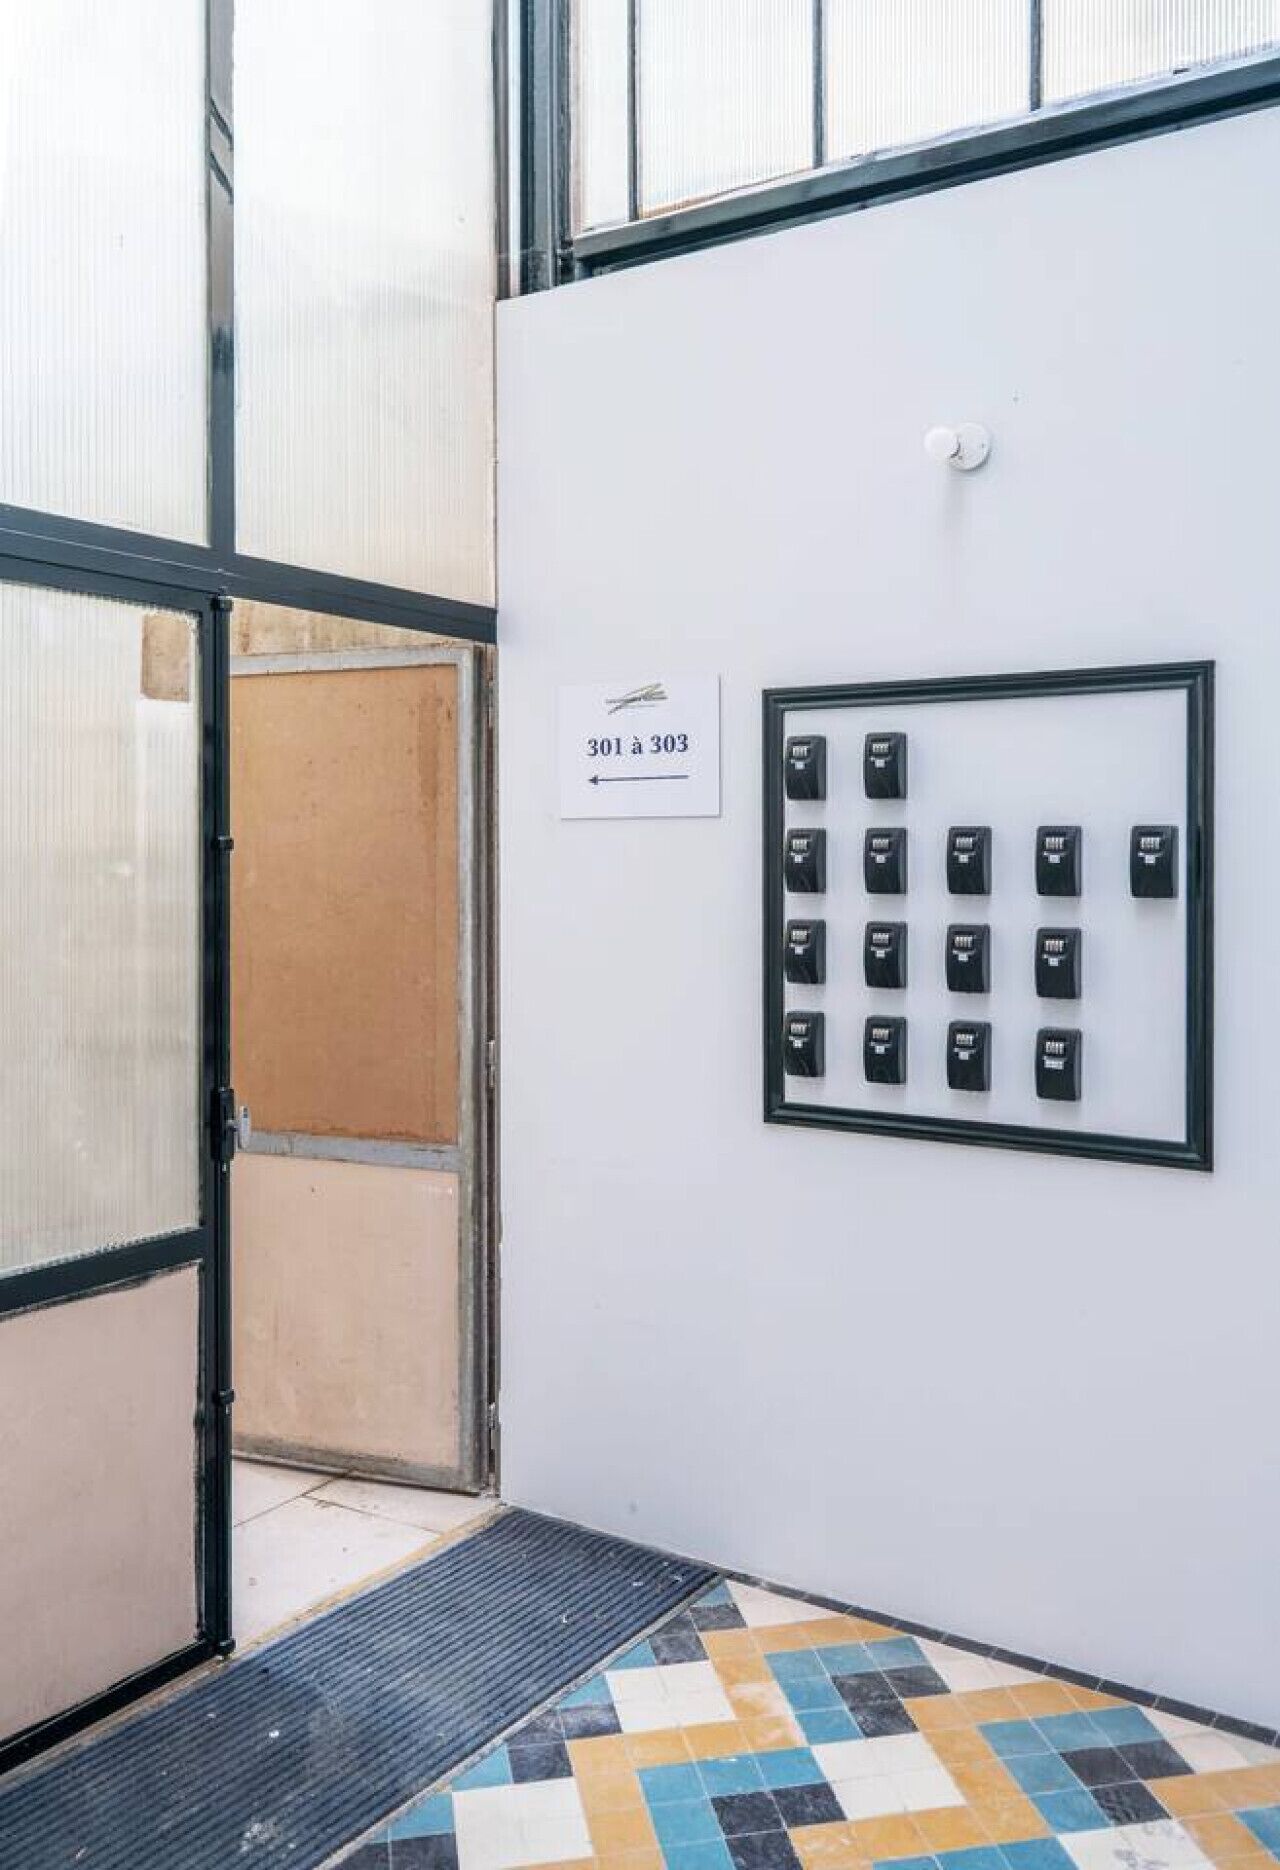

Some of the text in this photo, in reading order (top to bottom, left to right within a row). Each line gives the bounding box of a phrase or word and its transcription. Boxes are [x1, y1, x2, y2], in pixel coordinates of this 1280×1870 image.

[586, 734, 689, 757] 301 à 303
